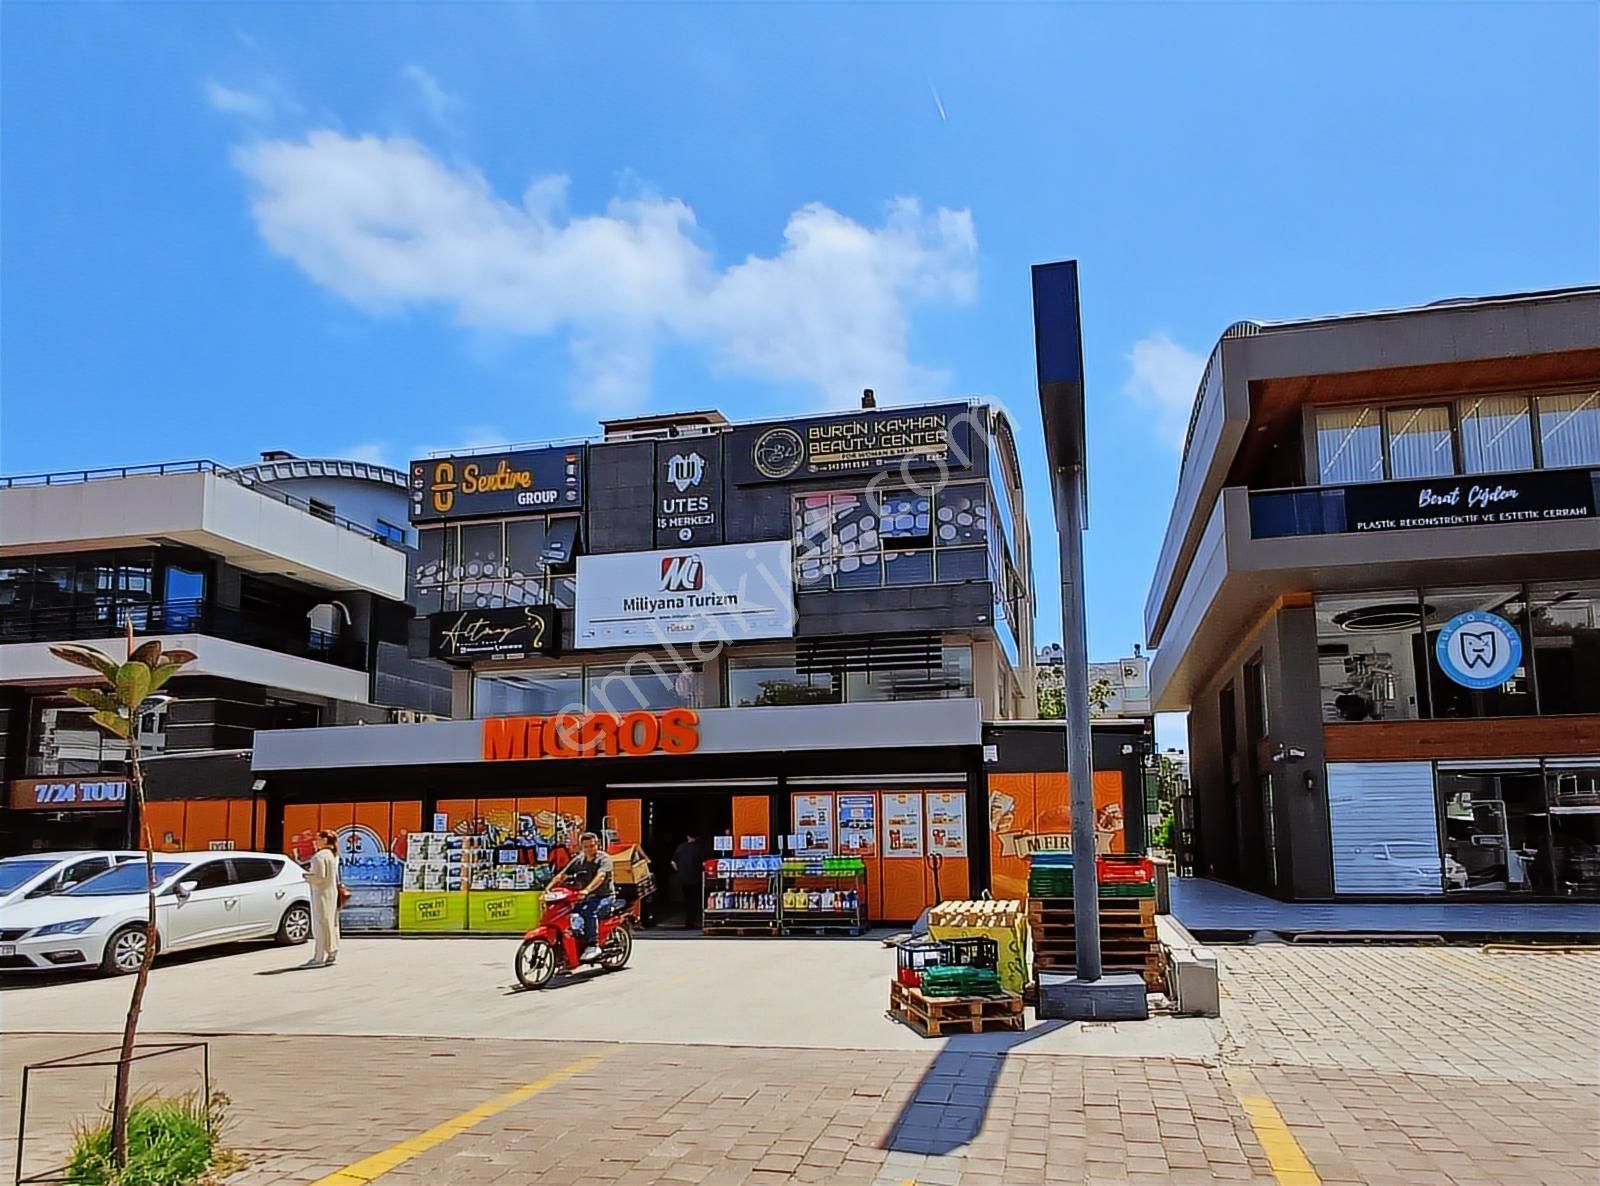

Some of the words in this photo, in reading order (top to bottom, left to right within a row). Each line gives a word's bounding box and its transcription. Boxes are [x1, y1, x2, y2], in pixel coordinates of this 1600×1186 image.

[809, 421, 868, 439] BURÇİN
[874, 415, 946, 432] KAYHAN
[809, 437, 876, 454] BEAUTY
[881, 430, 947, 447] CENTER
[517, 490, 557, 505] GROUP
[663, 497, 709, 513] UTES
[1419, 487, 1459, 508] Berat
[669, 513, 714, 527] MERKEZİ
[1357, 520, 1396, 530] PLASTİK
[1482, 513, 1496, 522] VE
[1500, 510, 1540, 520] ESTETİK
[623, 597, 684, 613] Miliyana
[689, 593, 738, 607] Turizm
[34, 783, 76, 803] 7/24
